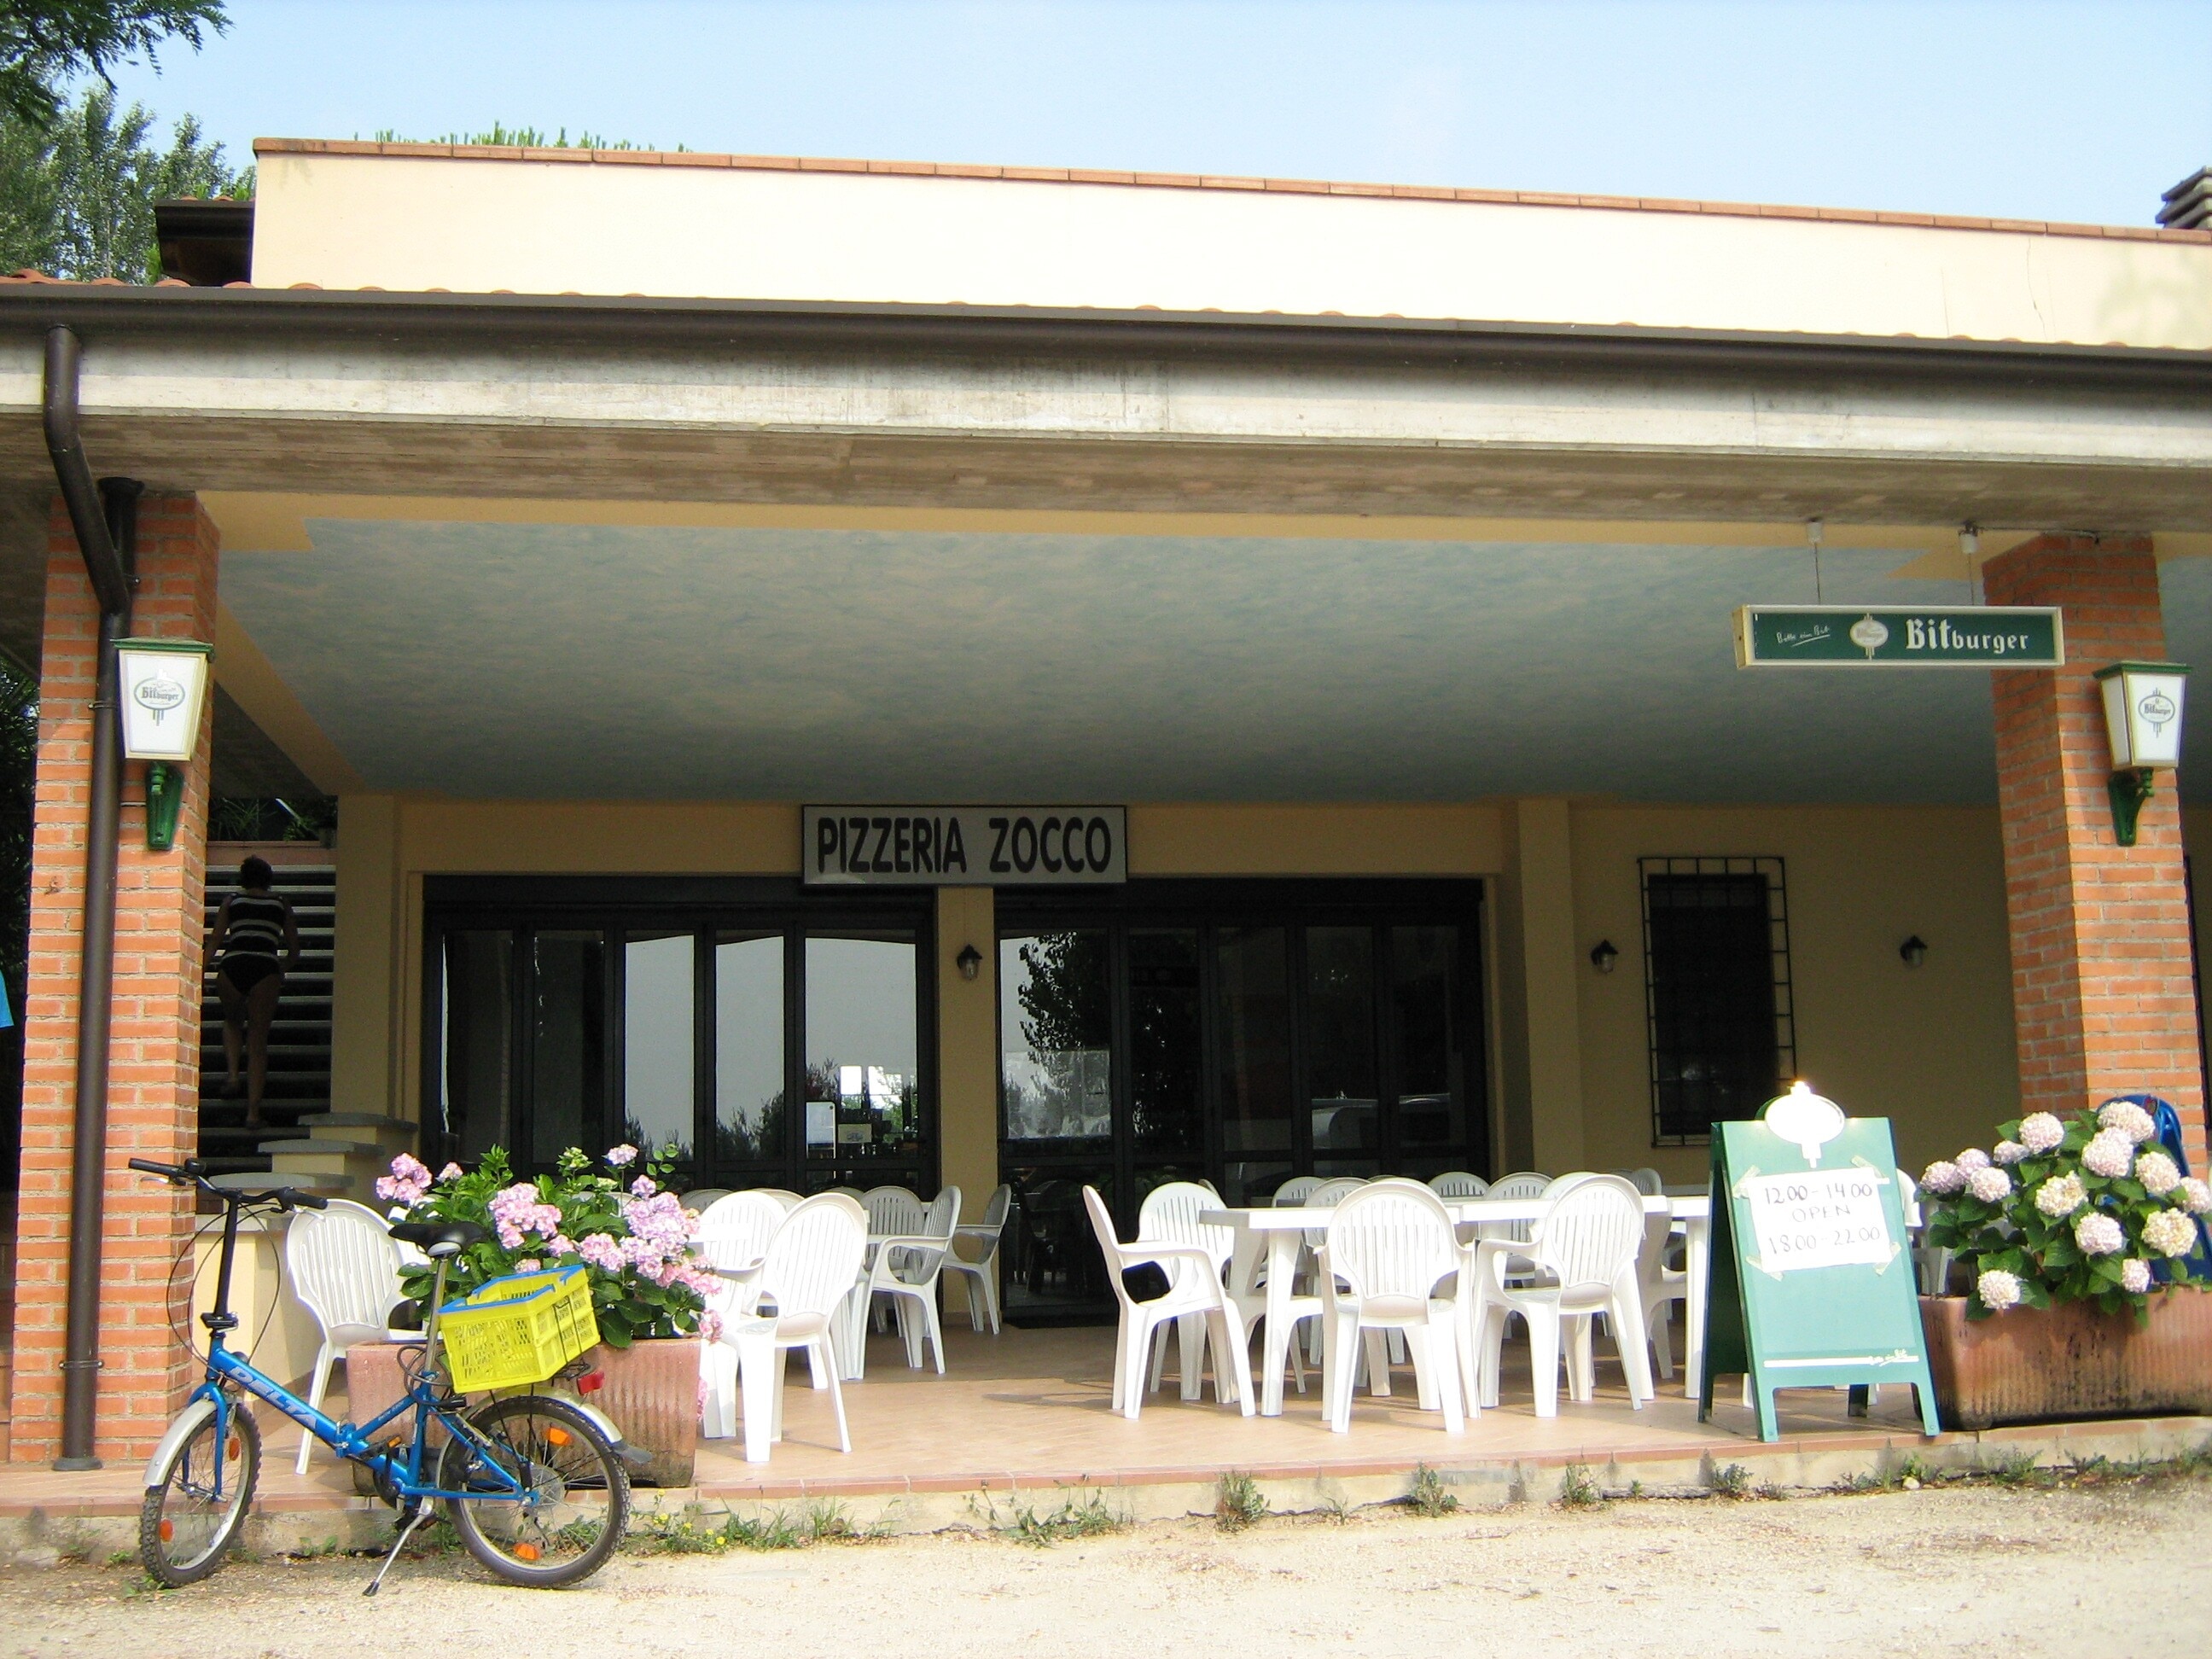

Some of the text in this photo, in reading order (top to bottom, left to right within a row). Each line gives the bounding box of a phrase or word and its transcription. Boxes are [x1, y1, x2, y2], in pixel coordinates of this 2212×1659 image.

[1905, 618, 2029, 655] Bitburger
[818, 817, 1112, 874] PIZZERIA ZOCCO
[1791, 1204, 1851, 1223] OPEN
[229, 1366, 317, 1429] DELTA
